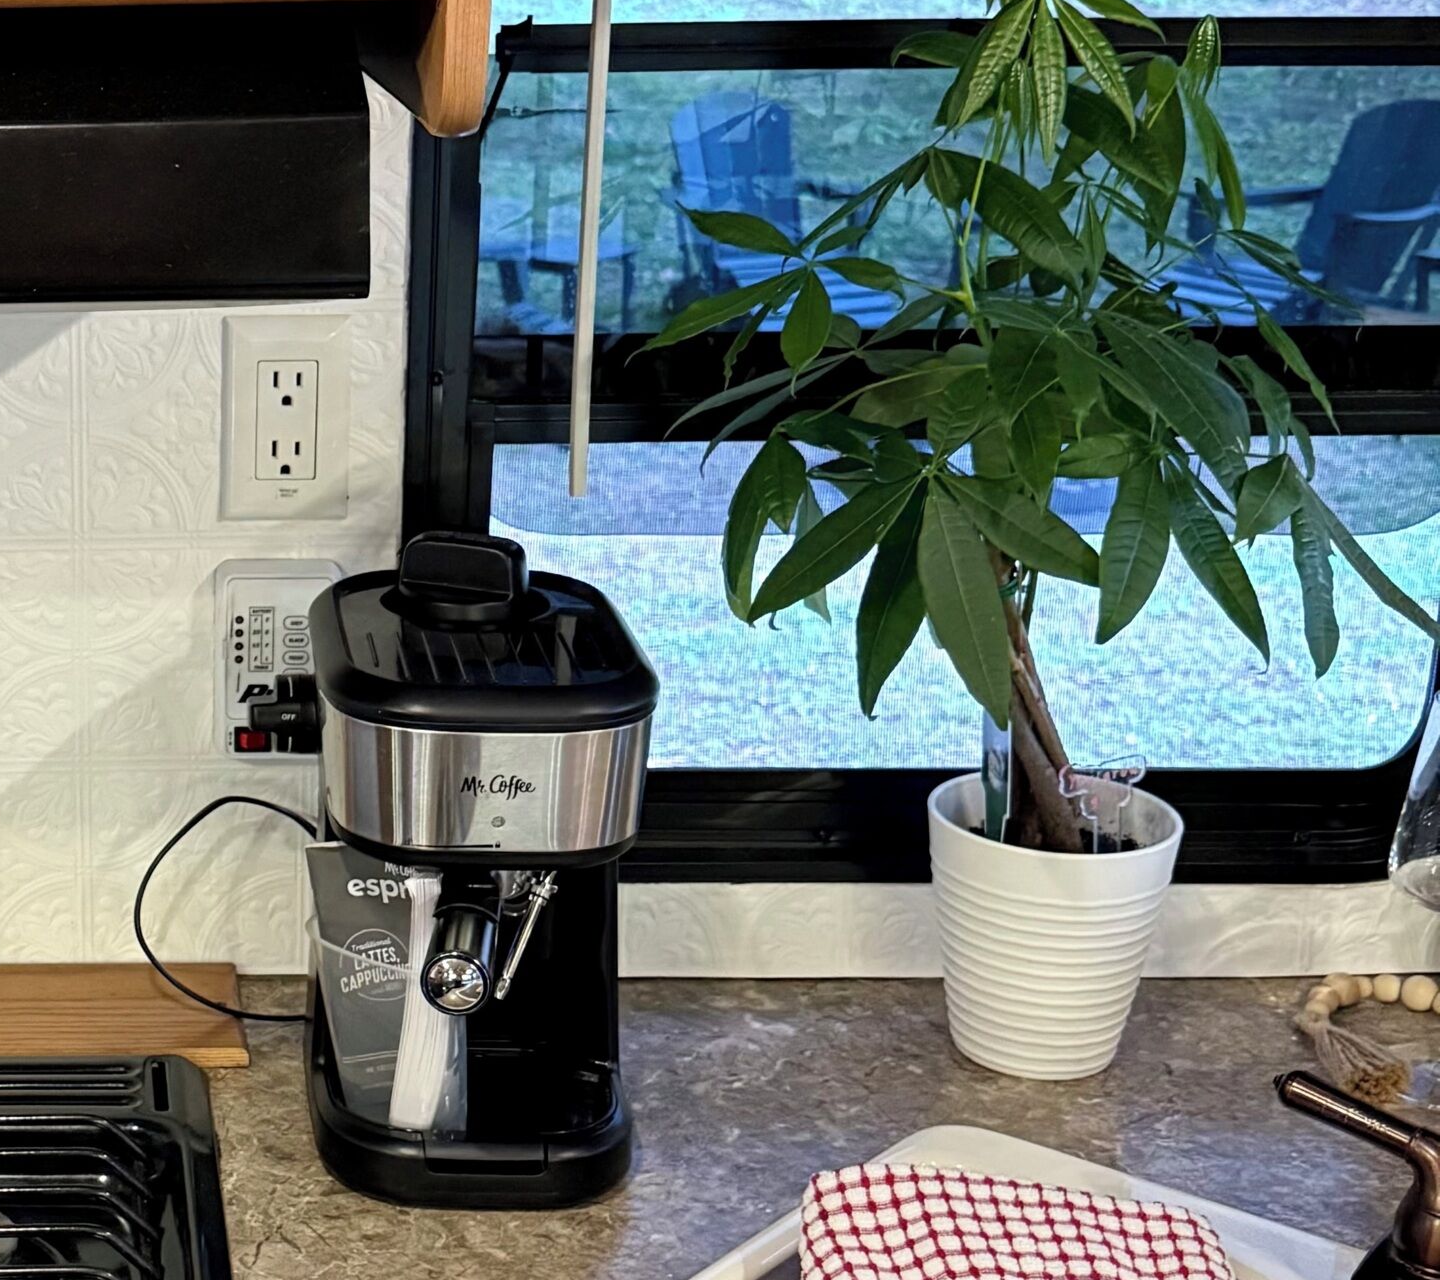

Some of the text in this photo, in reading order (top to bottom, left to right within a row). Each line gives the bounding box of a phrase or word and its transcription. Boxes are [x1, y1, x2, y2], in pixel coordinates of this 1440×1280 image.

[281, 713, 297, 721] OFF
[460, 774, 536, 800] Mr. Coffee
[347, 878, 410, 903] espr
[351, 937, 392, 952] Traditional
